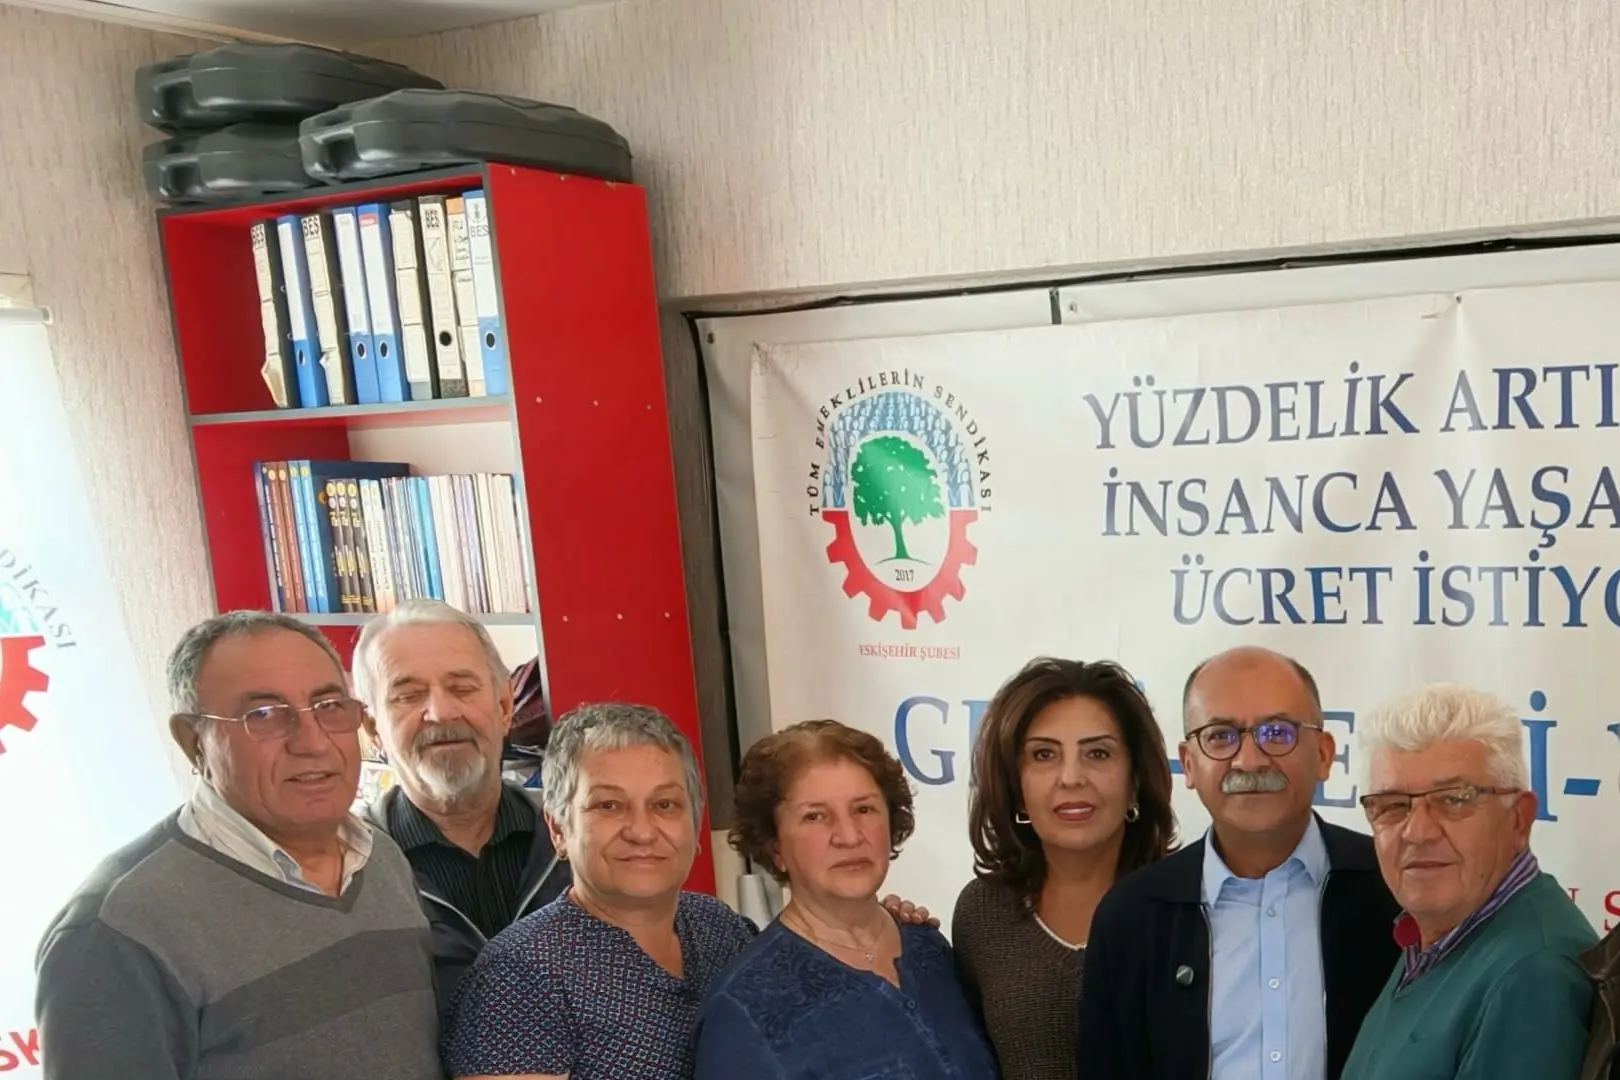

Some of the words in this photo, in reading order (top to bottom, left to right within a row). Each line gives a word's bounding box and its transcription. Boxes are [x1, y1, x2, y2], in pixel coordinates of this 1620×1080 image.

[1082, 361, 1416, 450] YÜZDELİK
[806, 463, 820, 516] TÜM
[816, 368, 925, 449] EMEKLİLERİN
[933, 385, 992, 513] SENDİKASI
[1100, 467, 1417, 538] İNSANCA
[895, 569, 915, 582] 2017
[1170, 553, 1393, 627] ÜCRET
[859, 641, 917, 659] ESKİŞEHİR
[920, 643, 961, 660] ŞUBESİ
